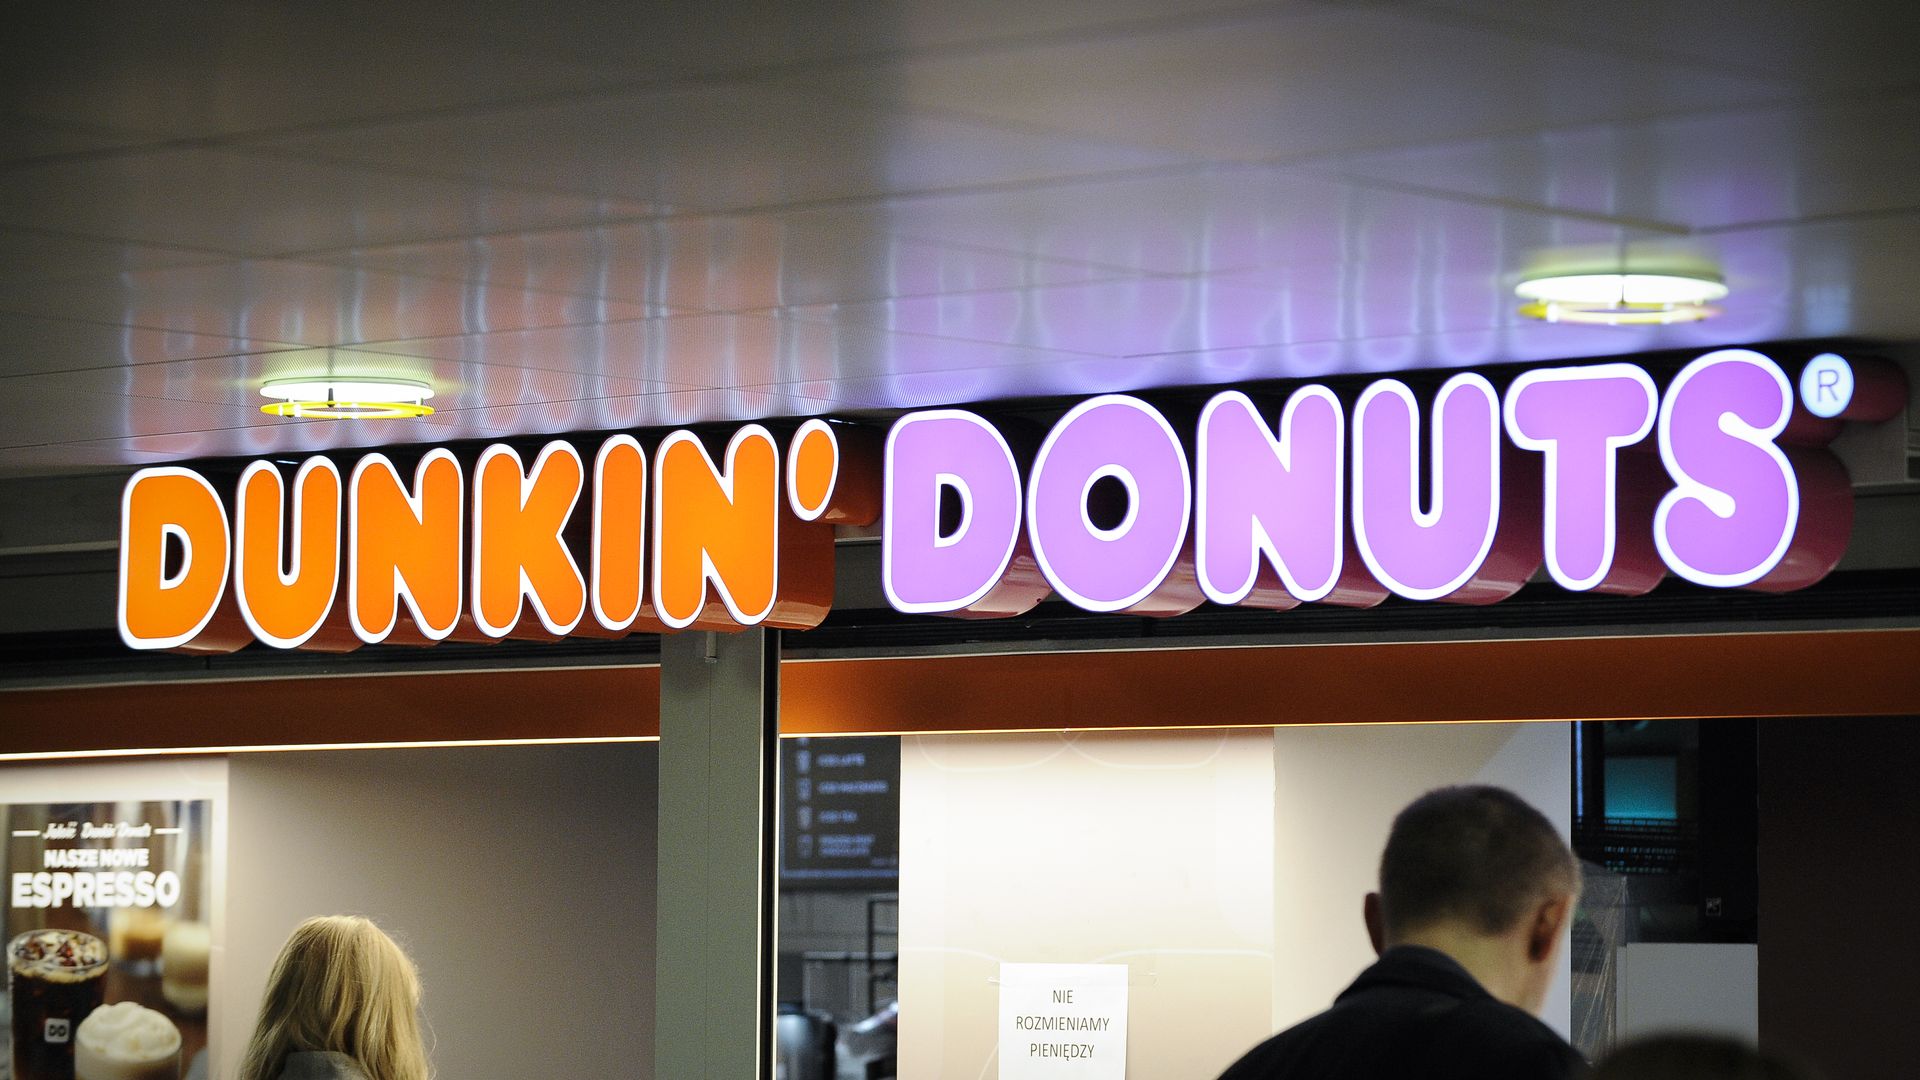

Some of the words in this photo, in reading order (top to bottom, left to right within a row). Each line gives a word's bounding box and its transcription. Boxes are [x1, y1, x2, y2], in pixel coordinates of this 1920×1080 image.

[118, 419, 839, 650] DUNKIN'
[882, 349, 1801, 613] DONUTS
[44, 849, 99, 868] NASZE
[100, 848, 149, 867] NOWE
[11, 870, 181, 908] ESPRESSO
[1052, 989, 1074, 1004] NIE
[1016, 1016, 1110, 1031] ROZMIENIAMY
[1030, 1043, 1095, 1061] PIENIĘDZY
